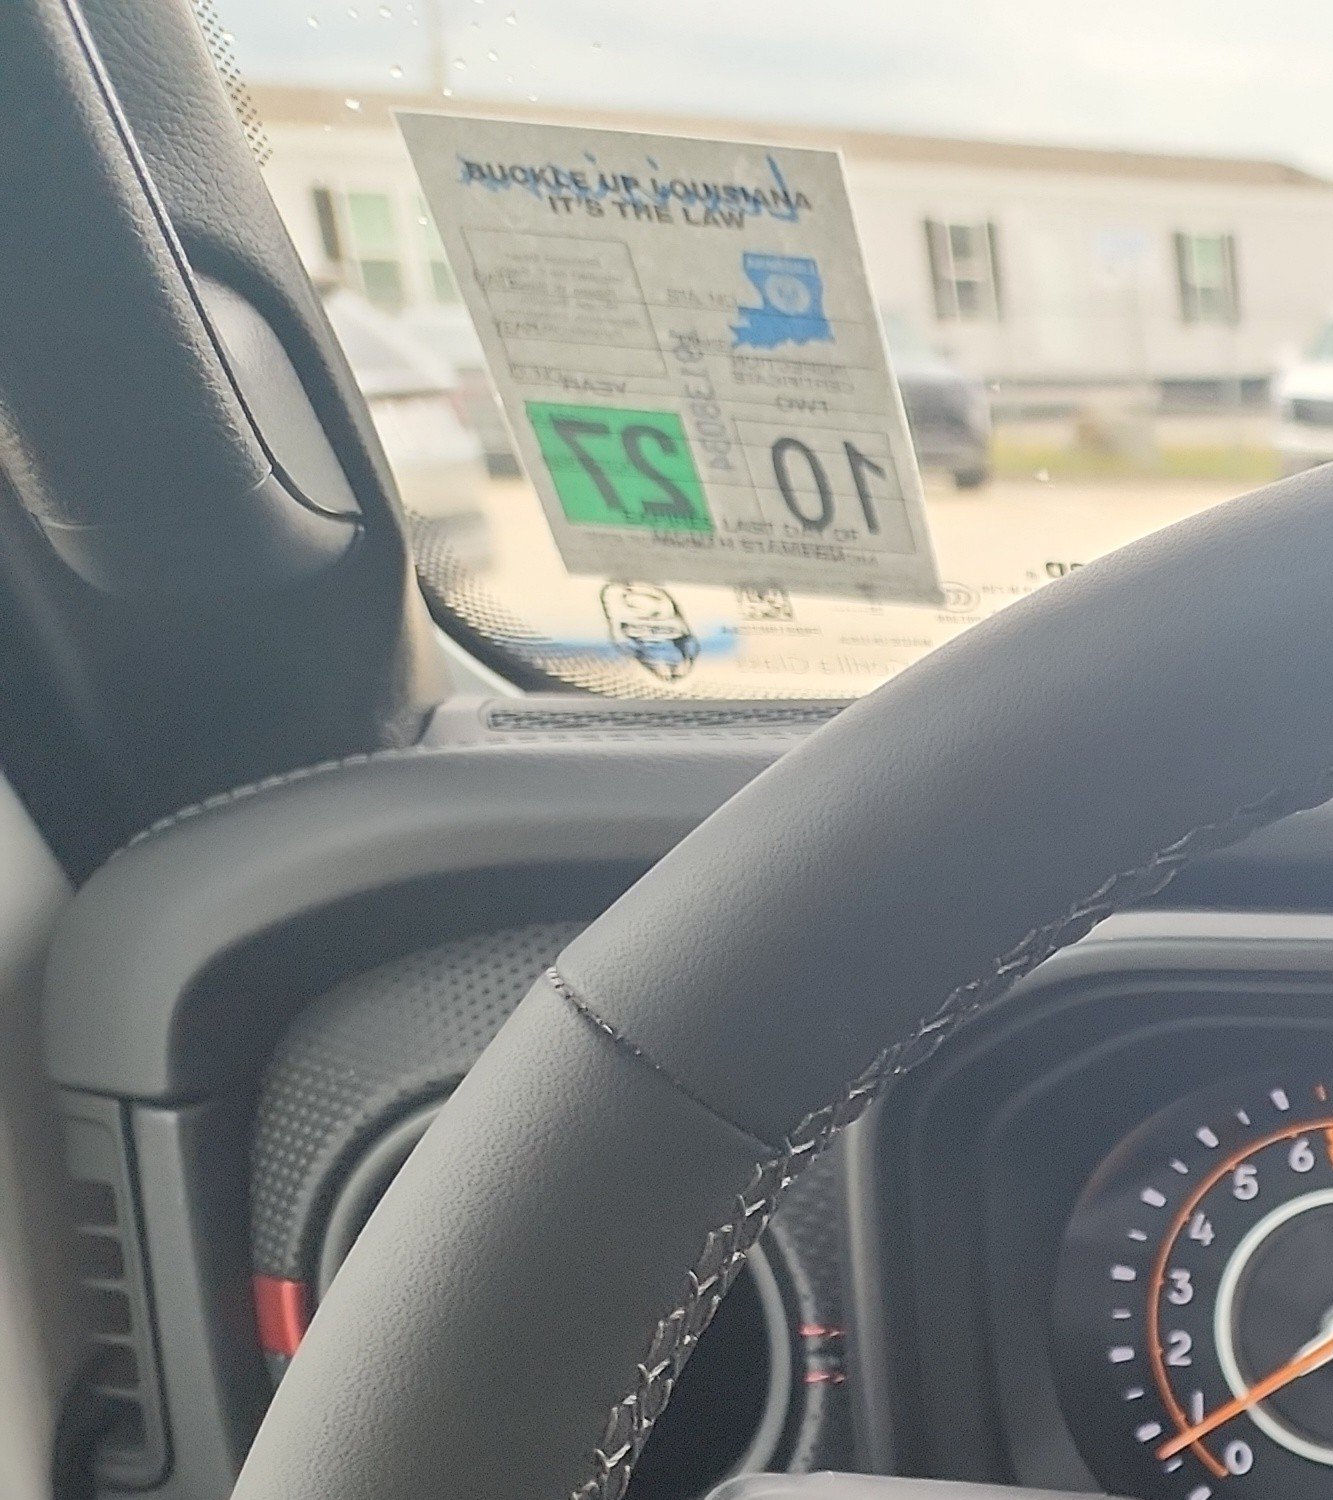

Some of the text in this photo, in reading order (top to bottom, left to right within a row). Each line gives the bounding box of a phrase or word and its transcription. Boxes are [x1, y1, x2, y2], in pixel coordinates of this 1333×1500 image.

[463, 160, 587, 190] BUCKLE
[596, 173, 640, 195] UP
[547, 194, 747, 231] IT'S THE LAW
[1289, 1140, 1315, 1173] 6
[1233, 1167, 1260, 1200] 5
[1188, 1213, 1216, 1247] 4
[1167, 1270, 1194, 1305] 3
[1167, 1331, 1192, 1367] 2
[1192, 1390, 1205, 1423] 1
[1226, 1440, 1253, 1476] 0
